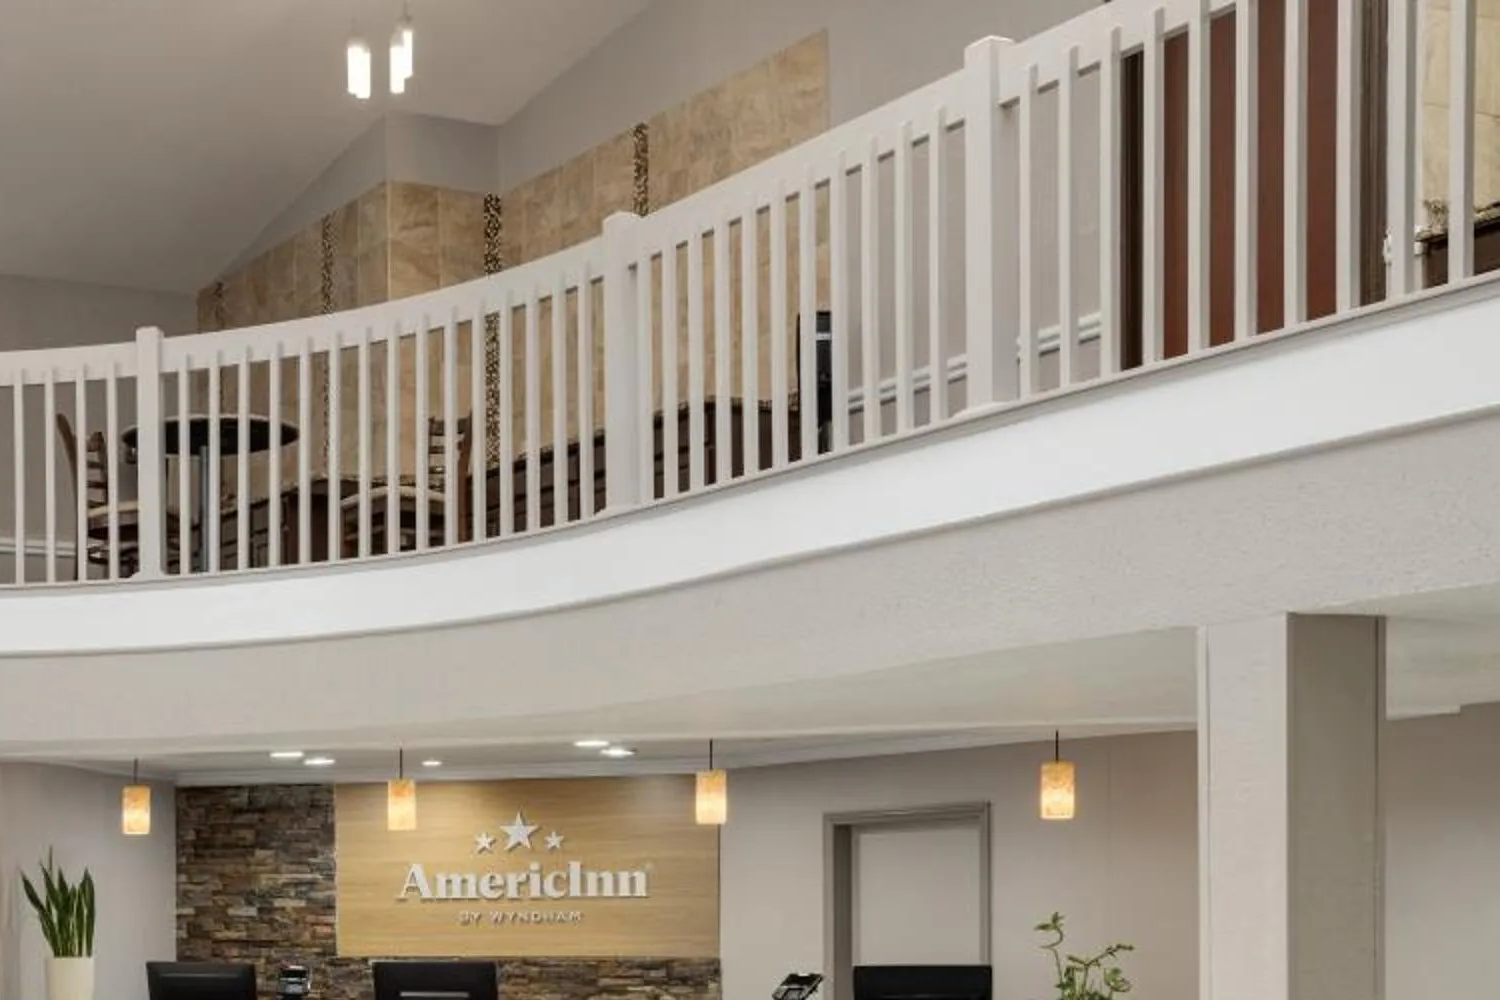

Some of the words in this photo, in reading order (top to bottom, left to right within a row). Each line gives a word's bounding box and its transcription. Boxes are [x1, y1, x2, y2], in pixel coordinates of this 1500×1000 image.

[399, 861, 649, 899] AmericInn
[459, 910, 481, 925] BY
[489, 910, 583, 925] WYNDHAM
